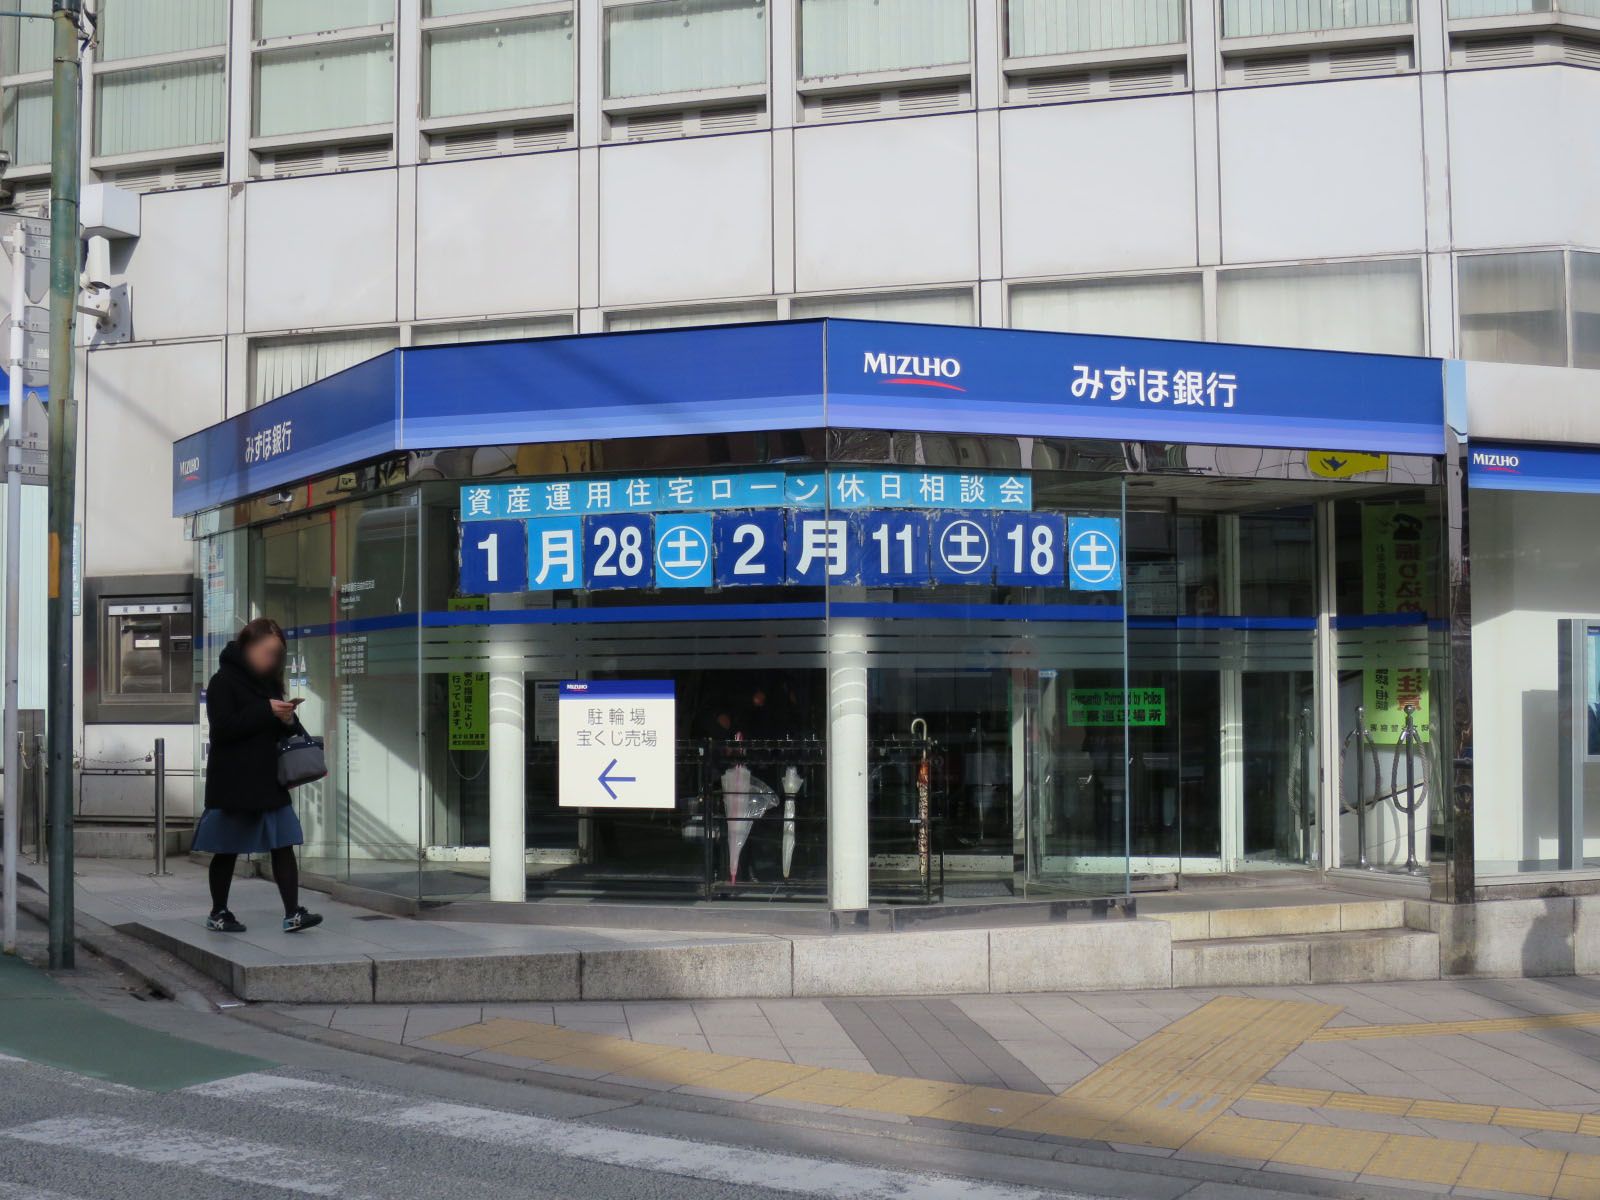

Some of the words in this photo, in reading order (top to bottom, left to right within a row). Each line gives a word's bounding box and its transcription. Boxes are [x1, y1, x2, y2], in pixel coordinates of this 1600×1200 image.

[863, 352, 962, 378] MIZUHO
[1071, 364, 1239, 409] みずほ銀行
[245, 420, 293, 464] みずほ銀行
[1472, 452, 1520, 468] MIZUHO
[467, 473, 1025, 516] 資産運用住宅ローン休日相談会
[587, 707, 646, 726] 駐輪場
[576, 729, 658, 748] 宝くじ売場
